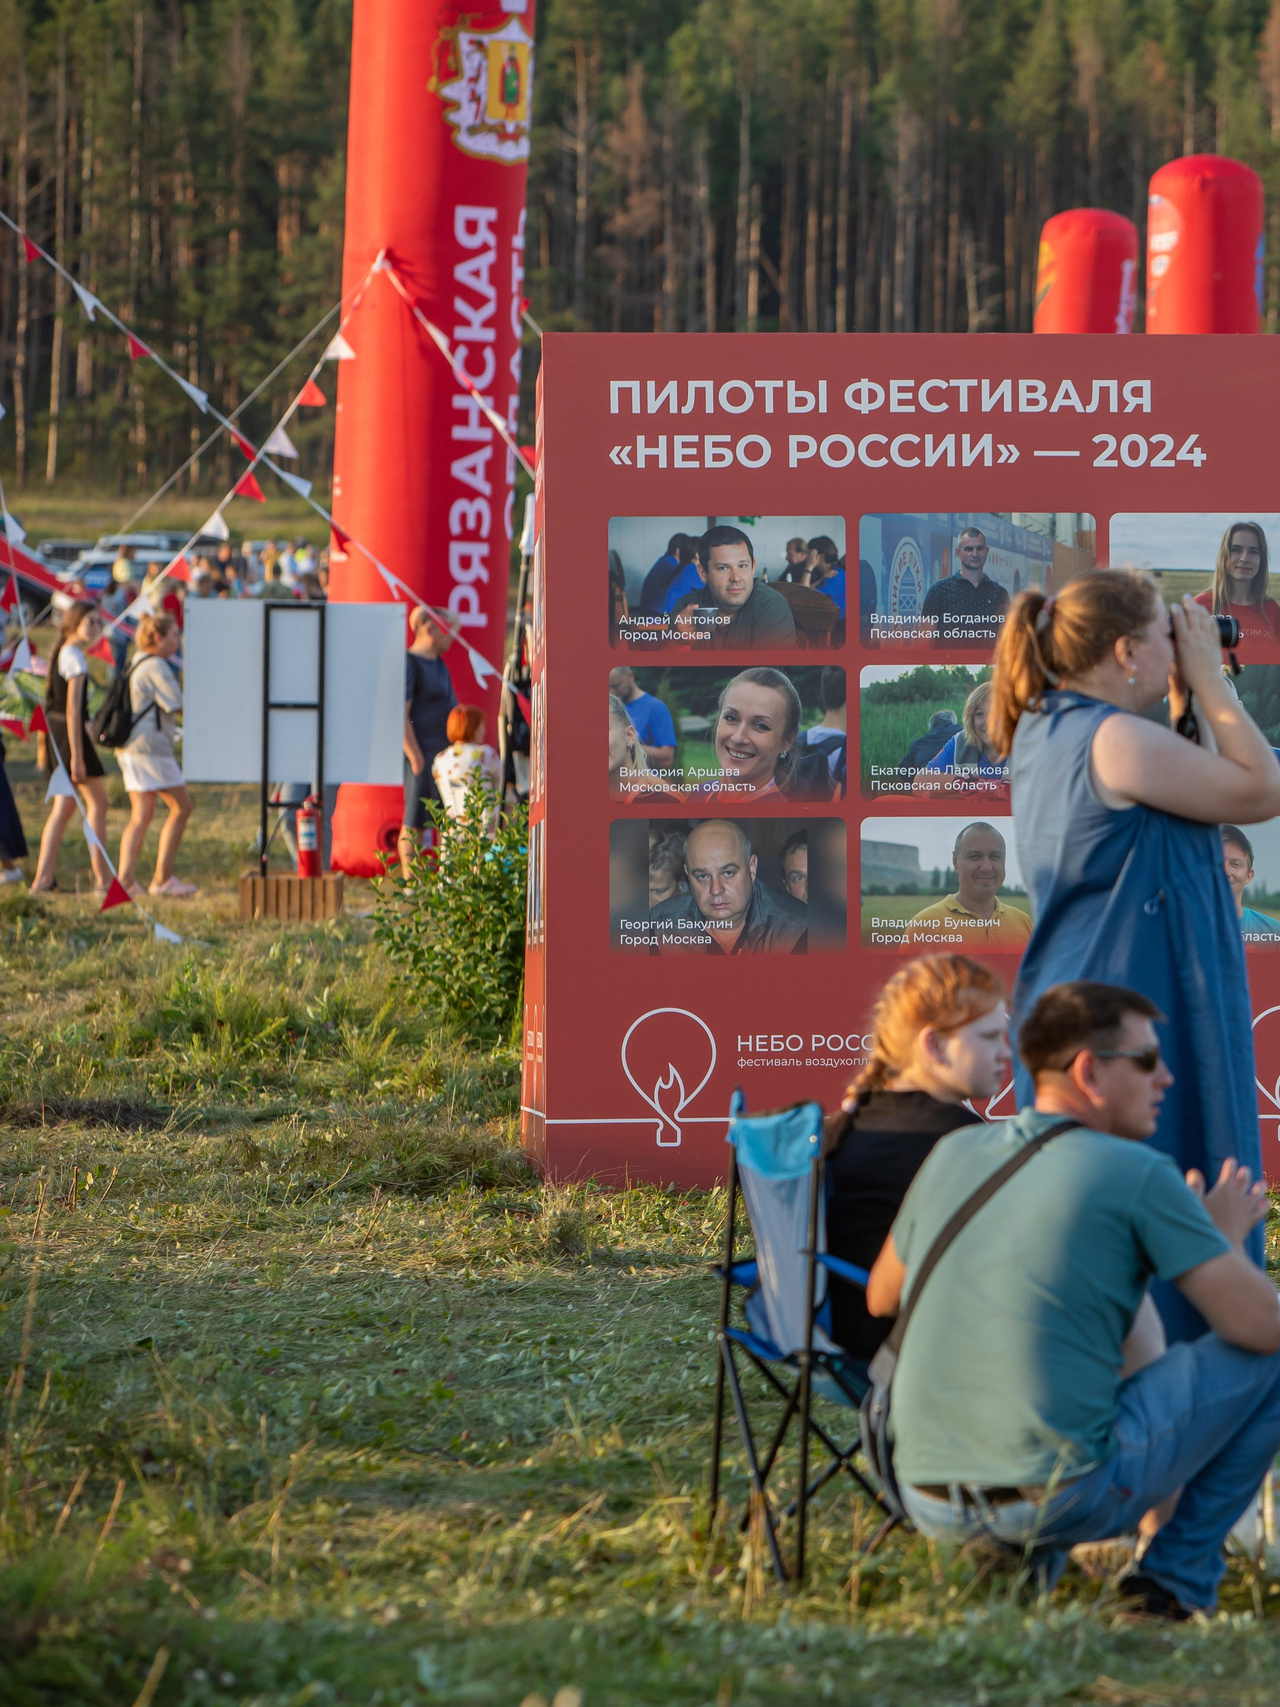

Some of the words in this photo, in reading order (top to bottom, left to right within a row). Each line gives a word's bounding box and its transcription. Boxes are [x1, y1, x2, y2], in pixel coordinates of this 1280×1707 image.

[609, 379, 828, 414] ПИЛОТЫ
[843, 378, 1152, 415] ФЕСТИВАЛЯ
[448, 204, 498, 628] РЯЗАНСКАЯ
[608, 433, 772, 469] «НЕБО
[788, 433, 1020, 469] РОССИИ»
[1091, 433, 1207, 468] 2024
[618, 613, 670, 627] Андрей
[674, 614, 731, 625] Антонов
[870, 613, 940, 626] Владимир
[943, 612, 1006, 625] Богданов
[619, 629, 658, 642] Город
[661, 629, 711, 641] Москва
[870, 628, 940, 639] Псковская
[943, 627, 996, 639] область
[619, 766, 684, 778] Виктория
[687, 766, 740, 778] Аршава
[871, 765, 941, 778] Екатерина
[944, 764, 1010, 777] Ларикова
[619, 781, 700, 793] Московская
[703, 781, 756, 792] область
[871, 780, 941, 791] Псковская
[944, 780, 997, 791] область
[620, 918, 673, 931] Георгий
[677, 918, 733, 931] Бакулин
[871, 917, 941, 929] Владимир
[944, 916, 1000, 929] Буневич
[620, 934, 659, 947] Город
[662, 934, 712, 945] Москва
[871, 932, 910, 945] Город
[913, 932, 963, 943] Москва
[737, 1034, 803, 1052] НЕБО
[811, 1034, 874, 1052] РОСС
[737, 1056, 802, 1068] фестиваль
[805, 1056, 870, 1068] воздухопл
